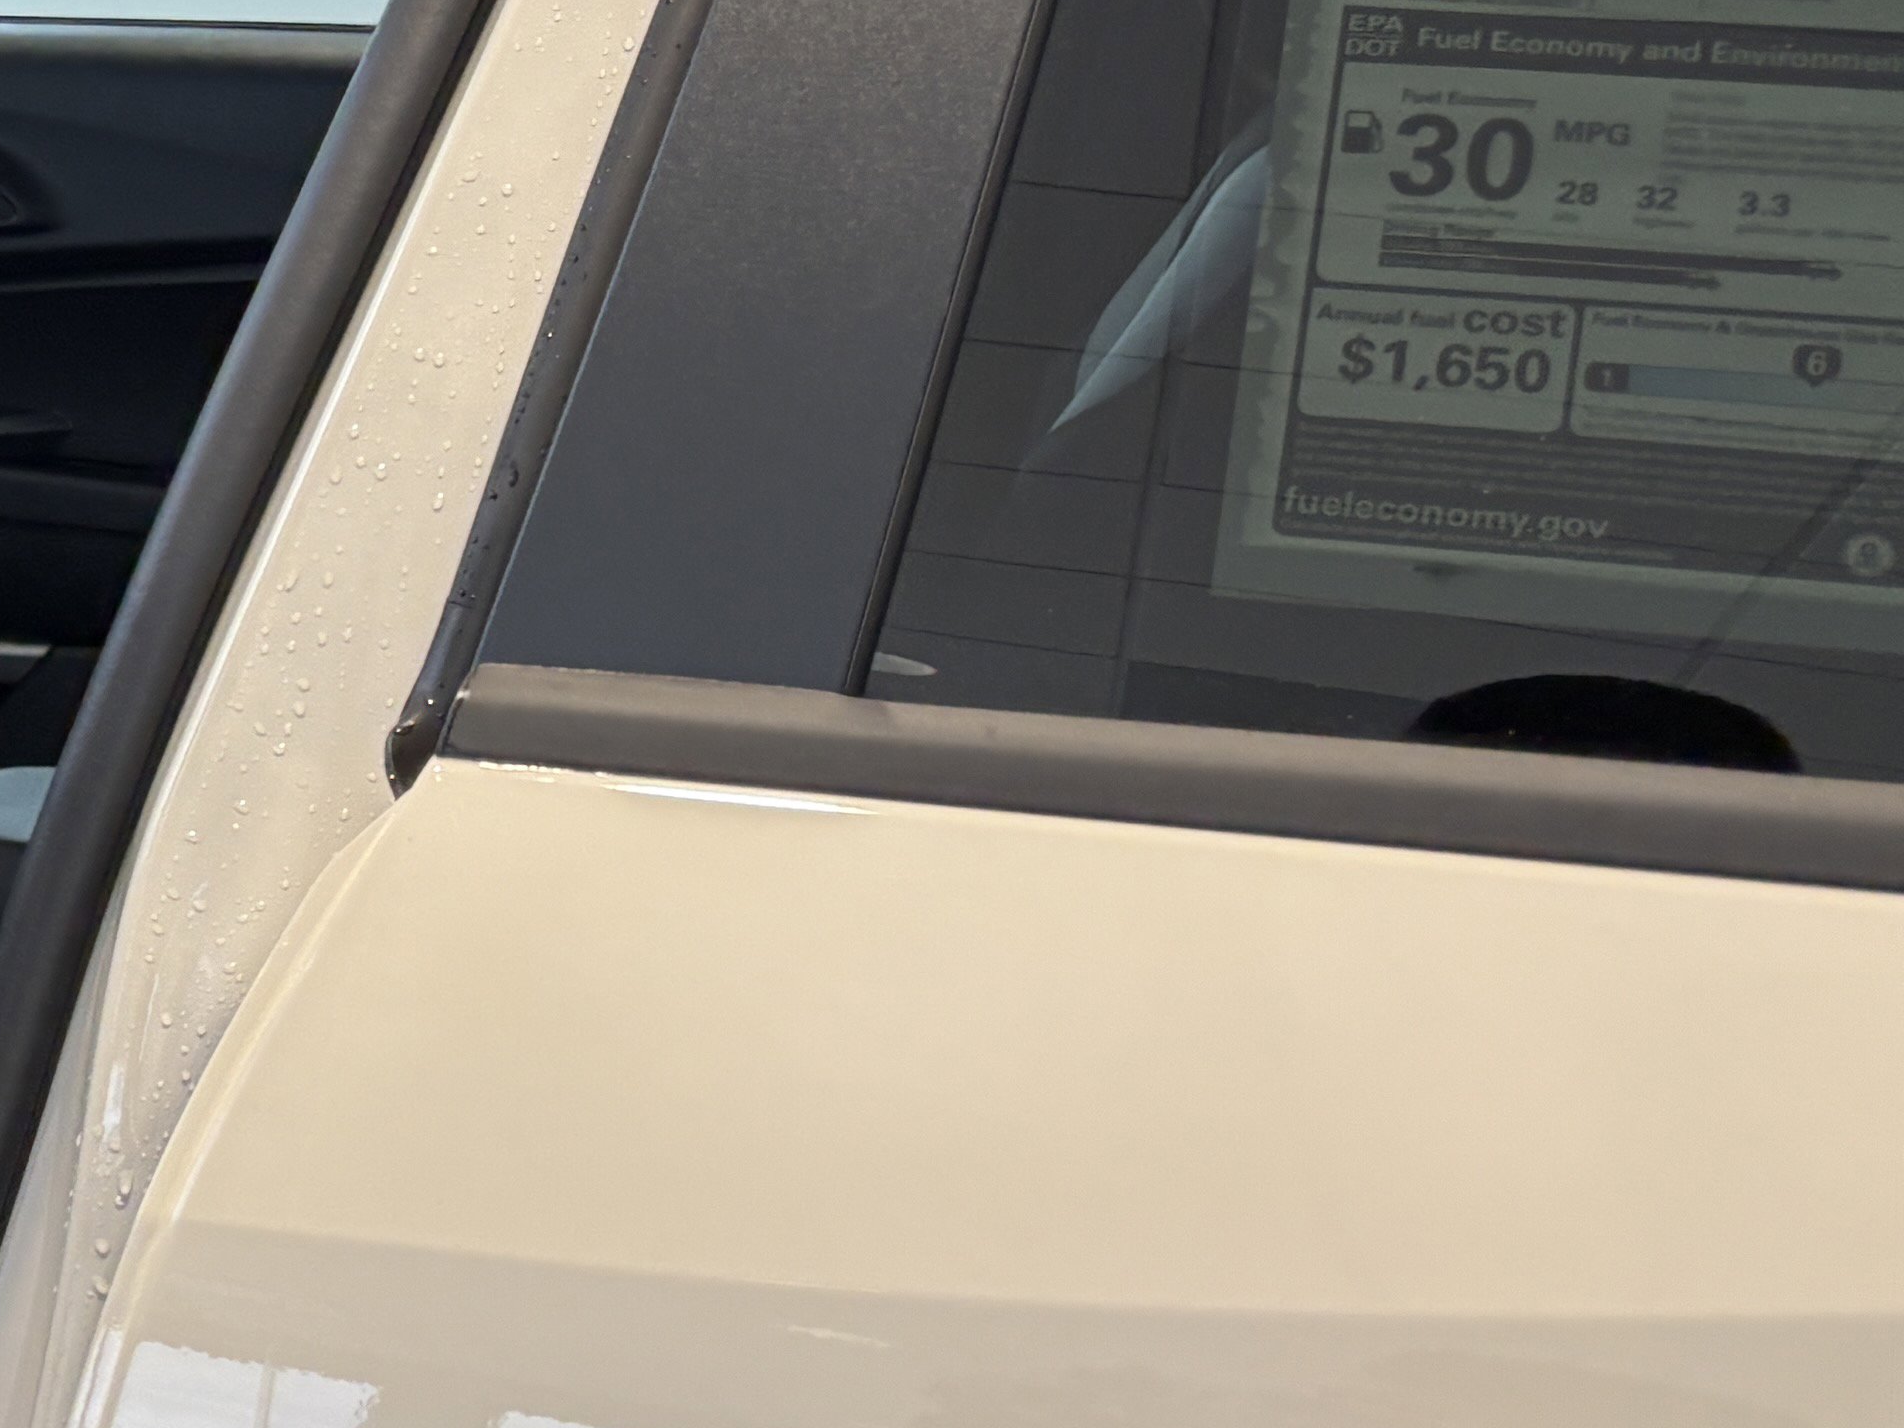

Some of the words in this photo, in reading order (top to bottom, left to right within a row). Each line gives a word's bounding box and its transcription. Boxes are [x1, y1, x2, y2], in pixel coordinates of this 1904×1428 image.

[1347, 13, 1405, 35] EPA
[1344, 37, 1402, 58] DOT
[1417, 28, 1482, 53] Fuel
[1490, 31, 1634, 65] Economy
[1642, 39, 1703, 63] and
[1388, 113, 1535, 202] 30
[1553, 119, 1632, 147] MPG
[1555, 180, 1599, 206] 28
[1635, 185, 1679, 212] 32
[1736, 191, 1792, 219] 3.3
[1462, 308, 1567, 339] cost
[1338, 332, 1552, 396] $1,650
[1806, 351, 1827, 377] 6
[1281, 484, 1610, 540] fueleconomy.gov
